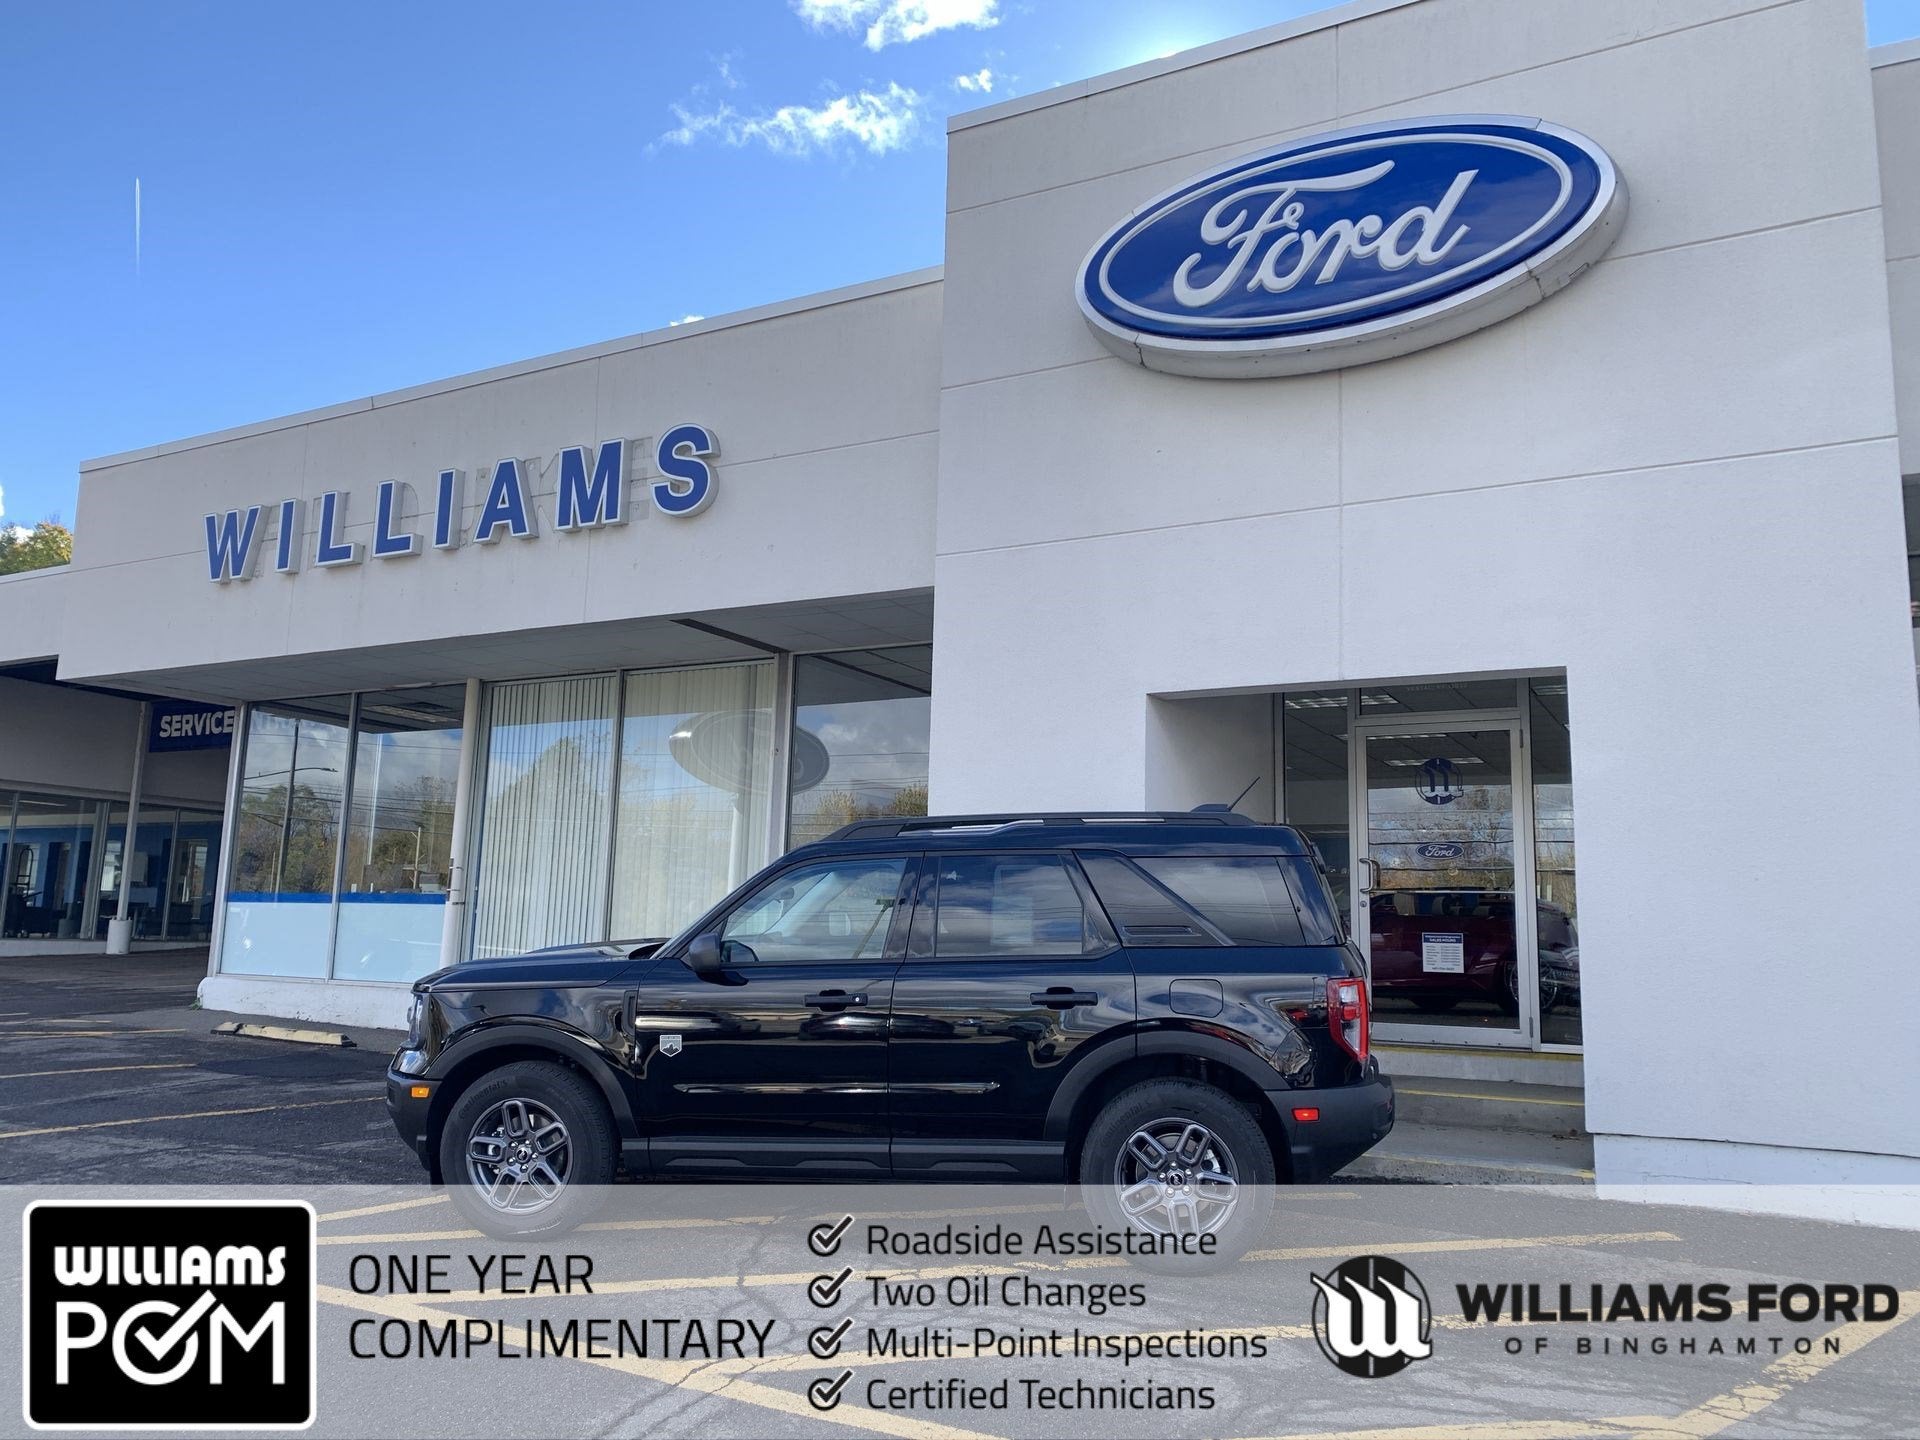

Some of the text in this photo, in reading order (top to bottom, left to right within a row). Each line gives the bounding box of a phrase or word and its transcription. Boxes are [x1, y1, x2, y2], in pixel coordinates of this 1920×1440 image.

[1172, 159, 1480, 308] Ford
[203, 422, 720, 584] WILLIAMS
[159, 709, 236, 738] SERVICE
[1425, 845, 1456, 857] Ford
